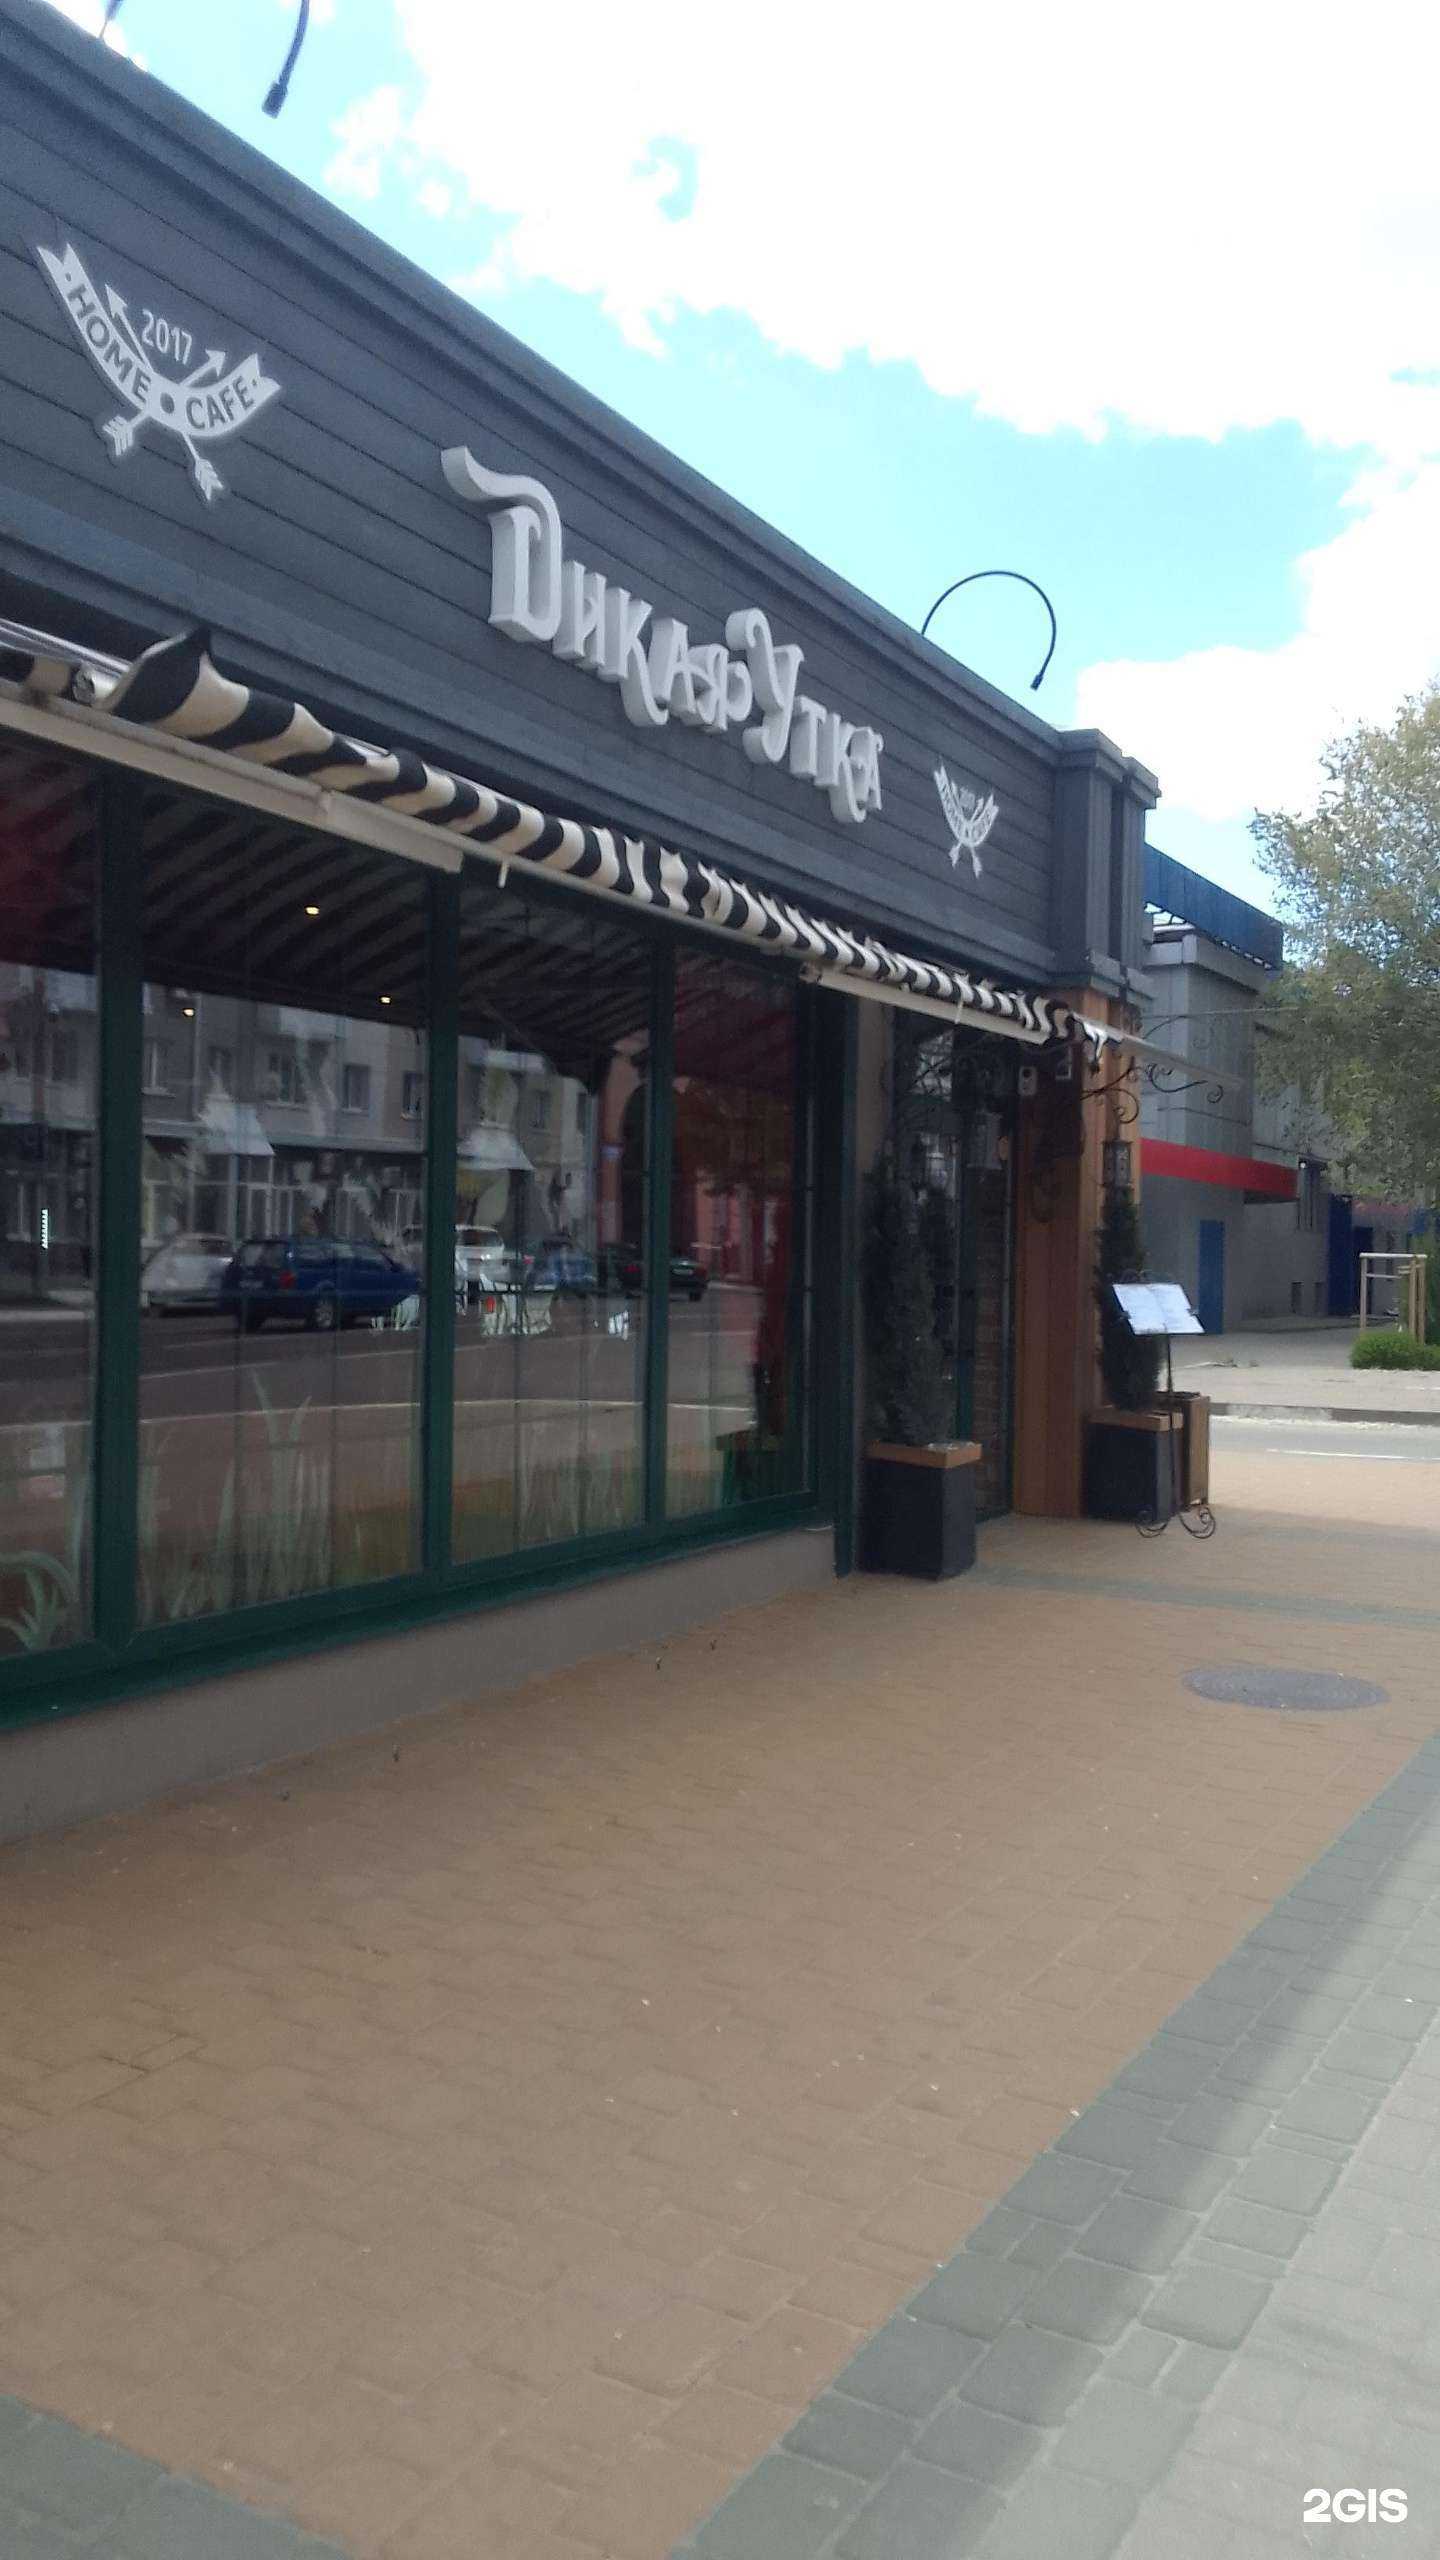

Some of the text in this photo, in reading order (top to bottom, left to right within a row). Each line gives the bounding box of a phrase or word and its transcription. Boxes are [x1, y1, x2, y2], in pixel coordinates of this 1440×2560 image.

[67, 285, 254, 430] HOME CAFE
[141, 308, 193, 365] 2017
